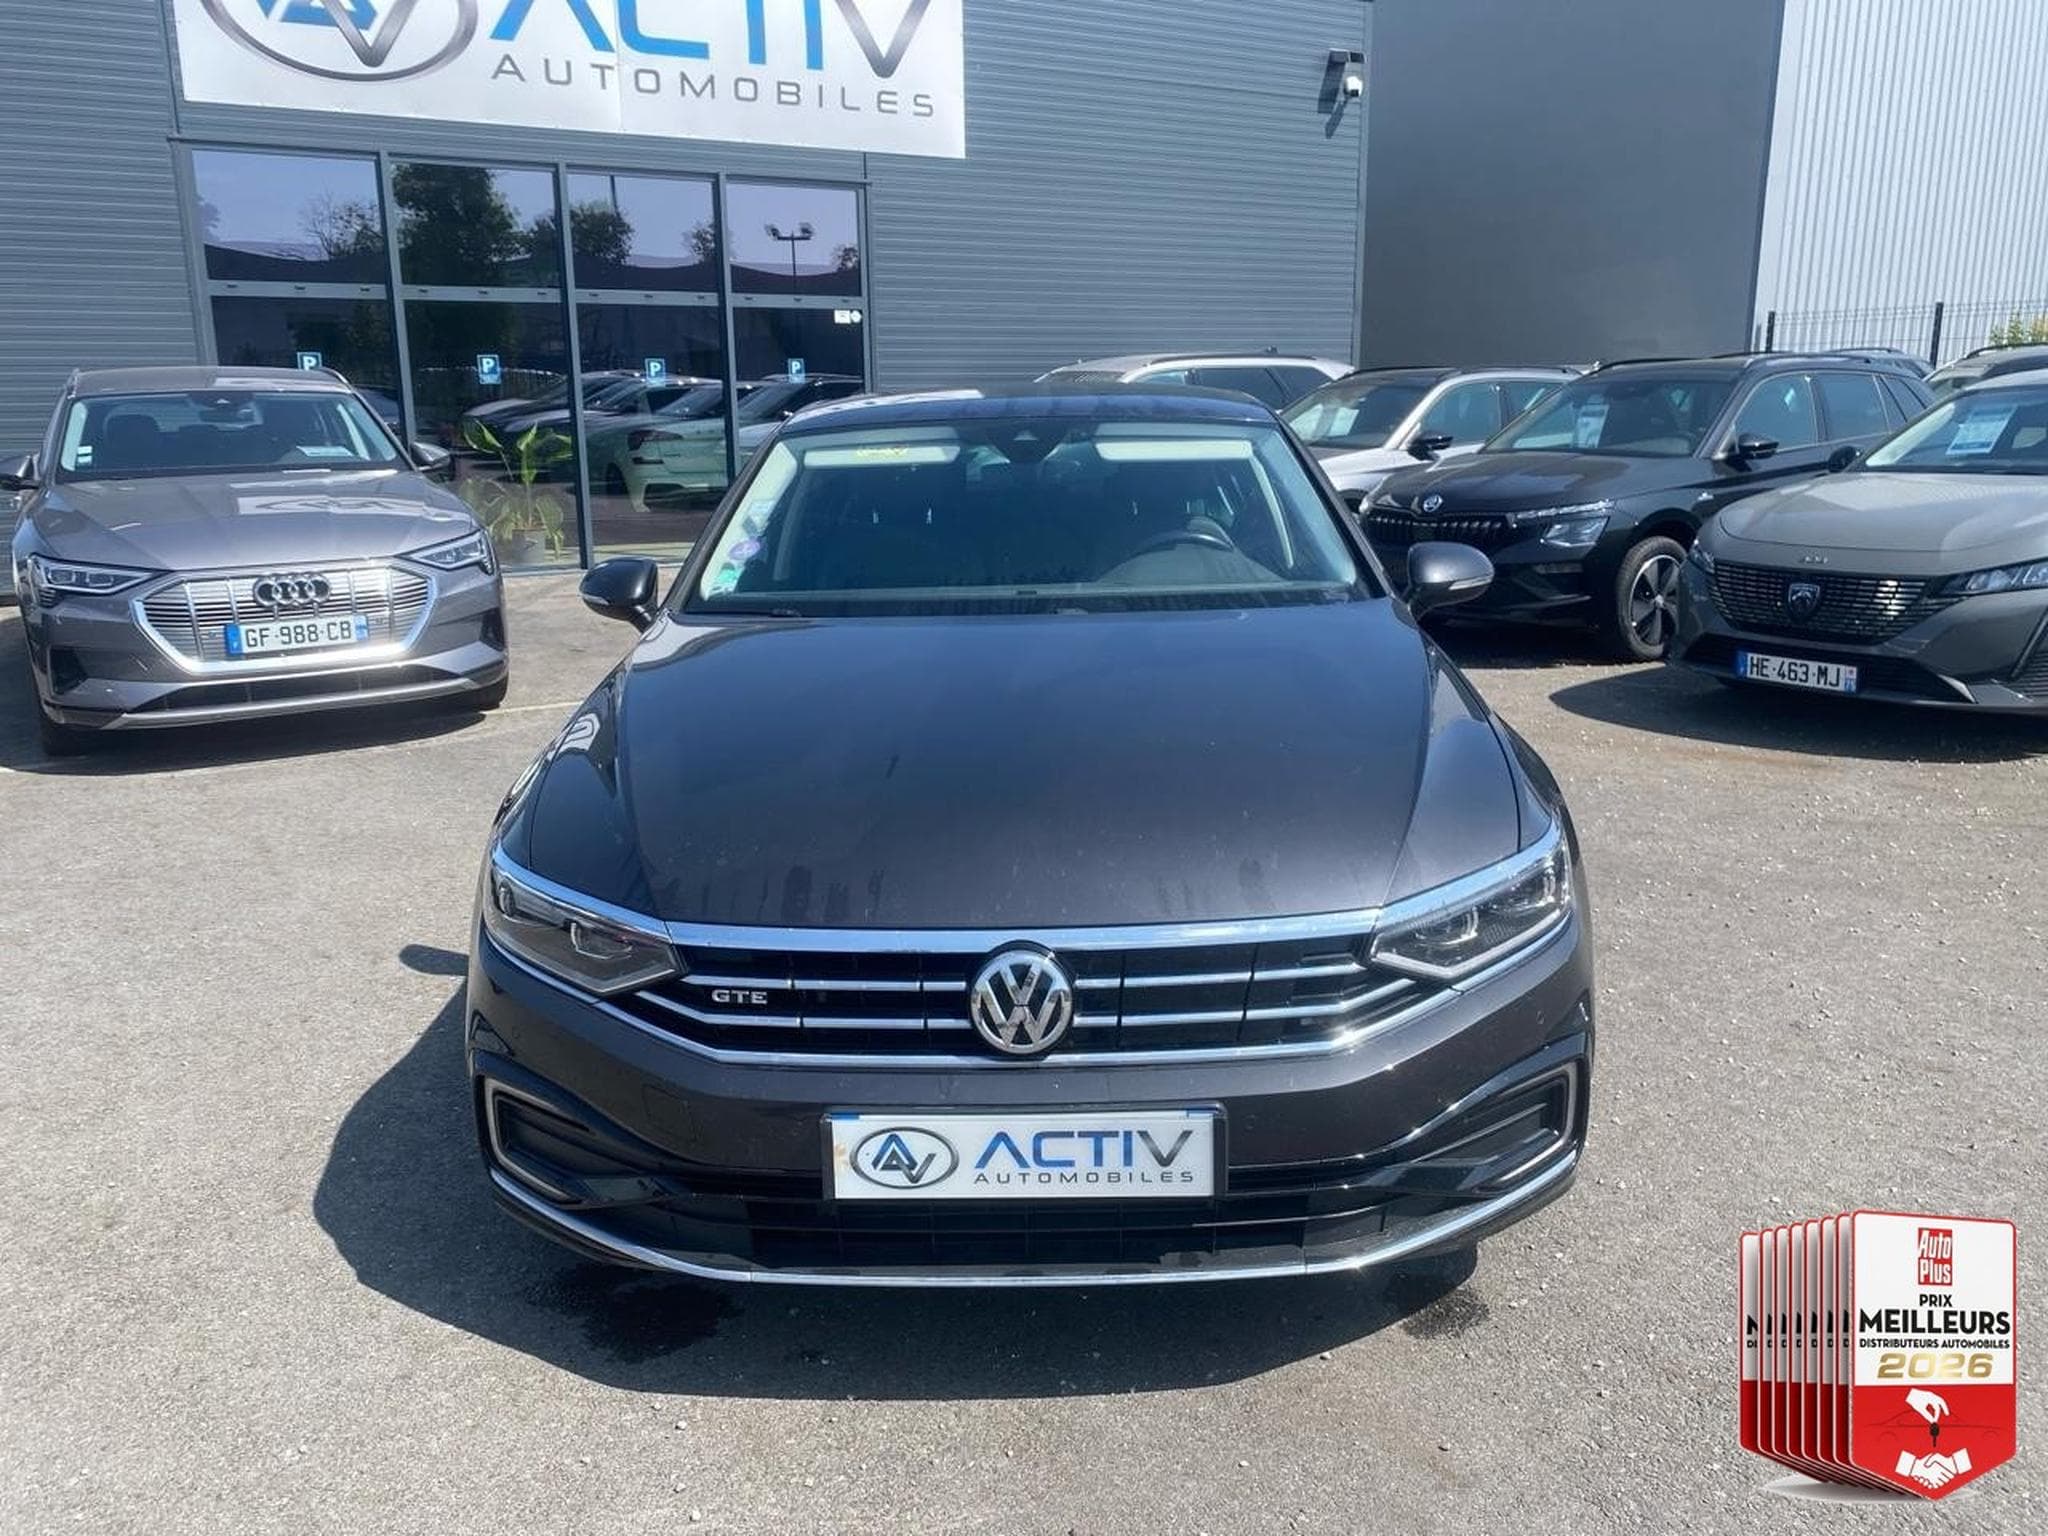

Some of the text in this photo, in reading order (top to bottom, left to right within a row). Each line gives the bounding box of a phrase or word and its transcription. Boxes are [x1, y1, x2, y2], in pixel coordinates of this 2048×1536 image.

[491, 53, 934, 117] AUTOMOBILES
[711, 989, 768, 1004] GTE
[974, 1130, 1193, 1169] ACTIV
[974, 1170, 1193, 1184] AUTOMOBILES
